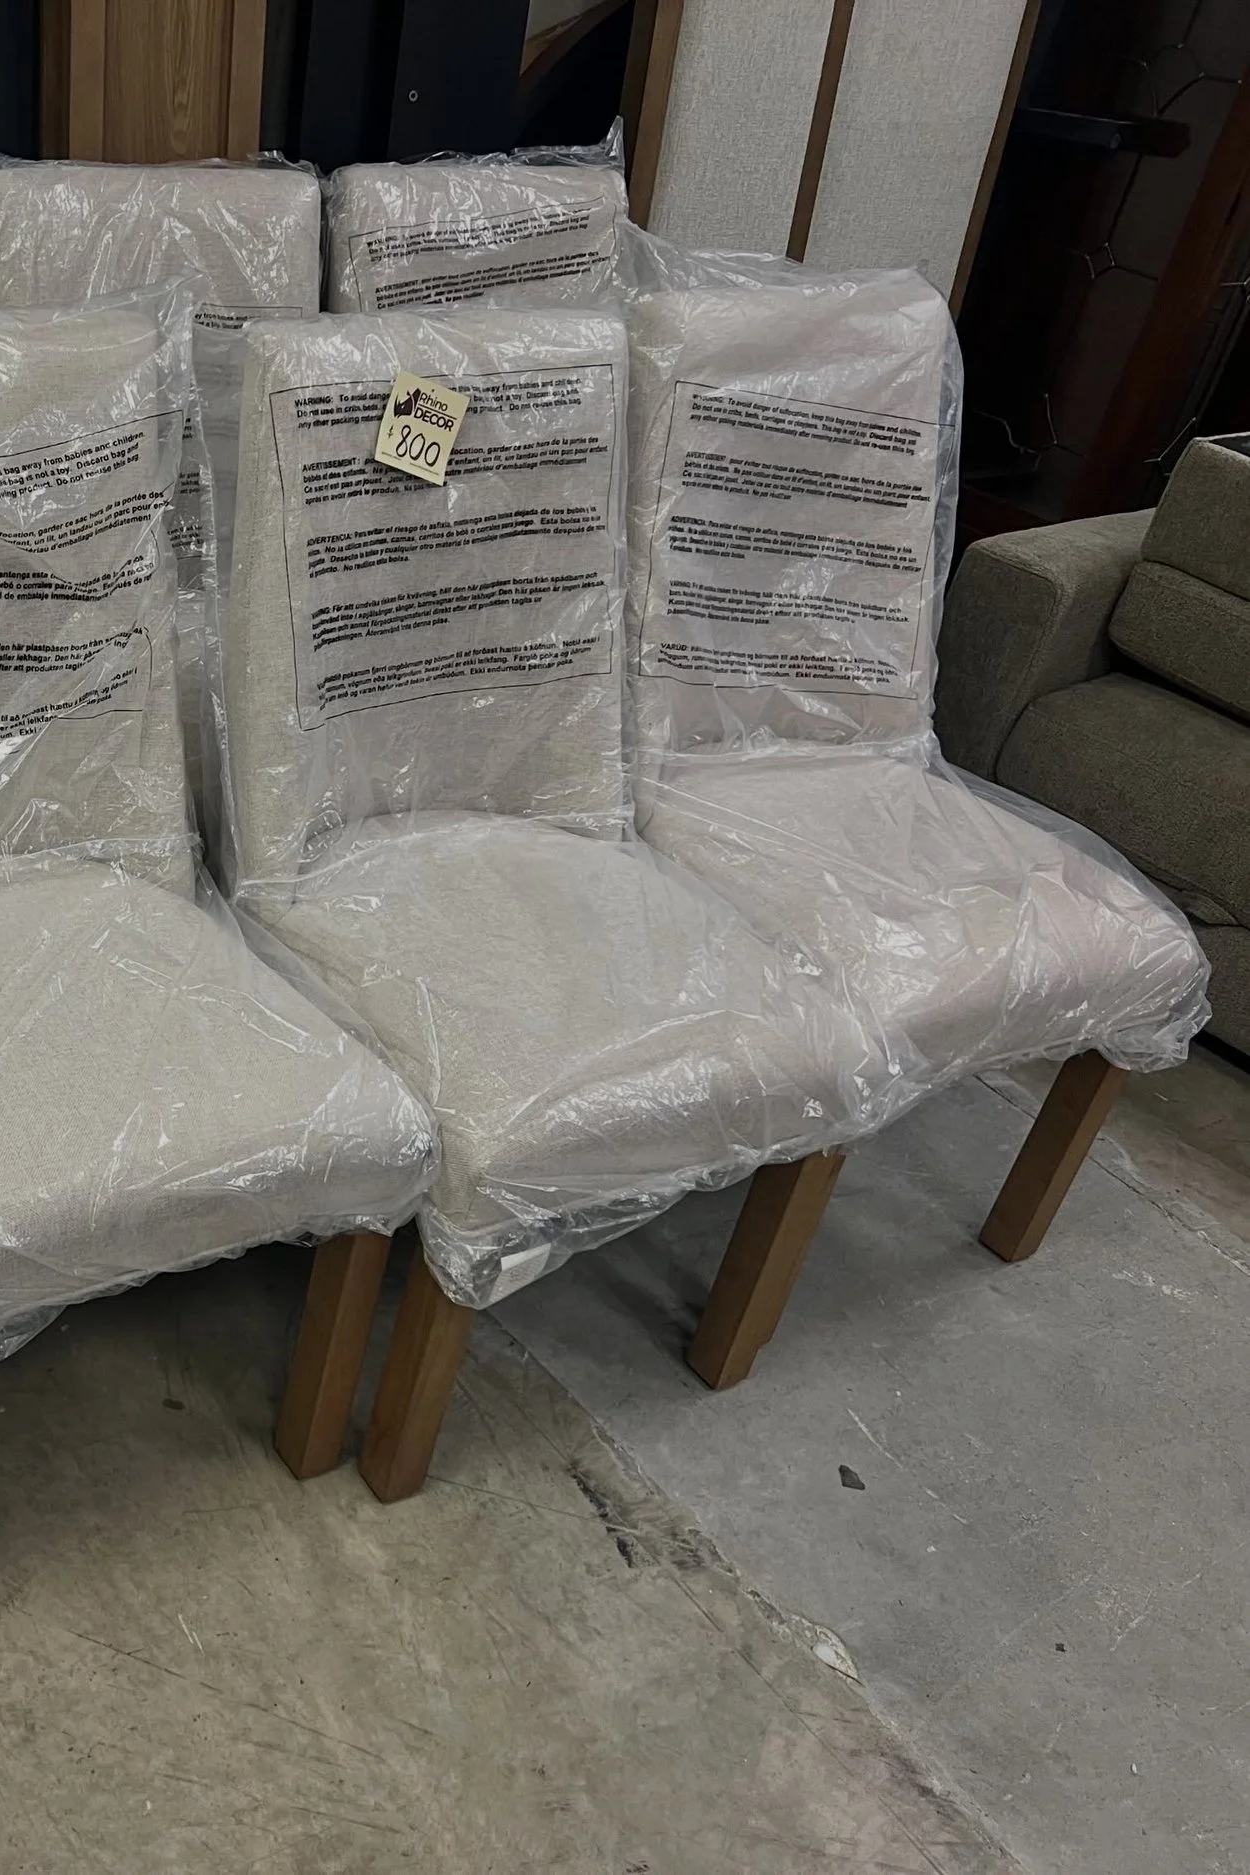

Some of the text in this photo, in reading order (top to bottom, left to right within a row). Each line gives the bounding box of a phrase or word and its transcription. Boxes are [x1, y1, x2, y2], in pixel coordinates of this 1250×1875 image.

[419, 393, 448, 412] Rhino
[414, 407, 454, 432] DECOR
[111, 450, 126, 459] bag
[488, 446, 511, 455] garder
[44, 456, 63, 466] from
[57, 477, 68, 486] Do
